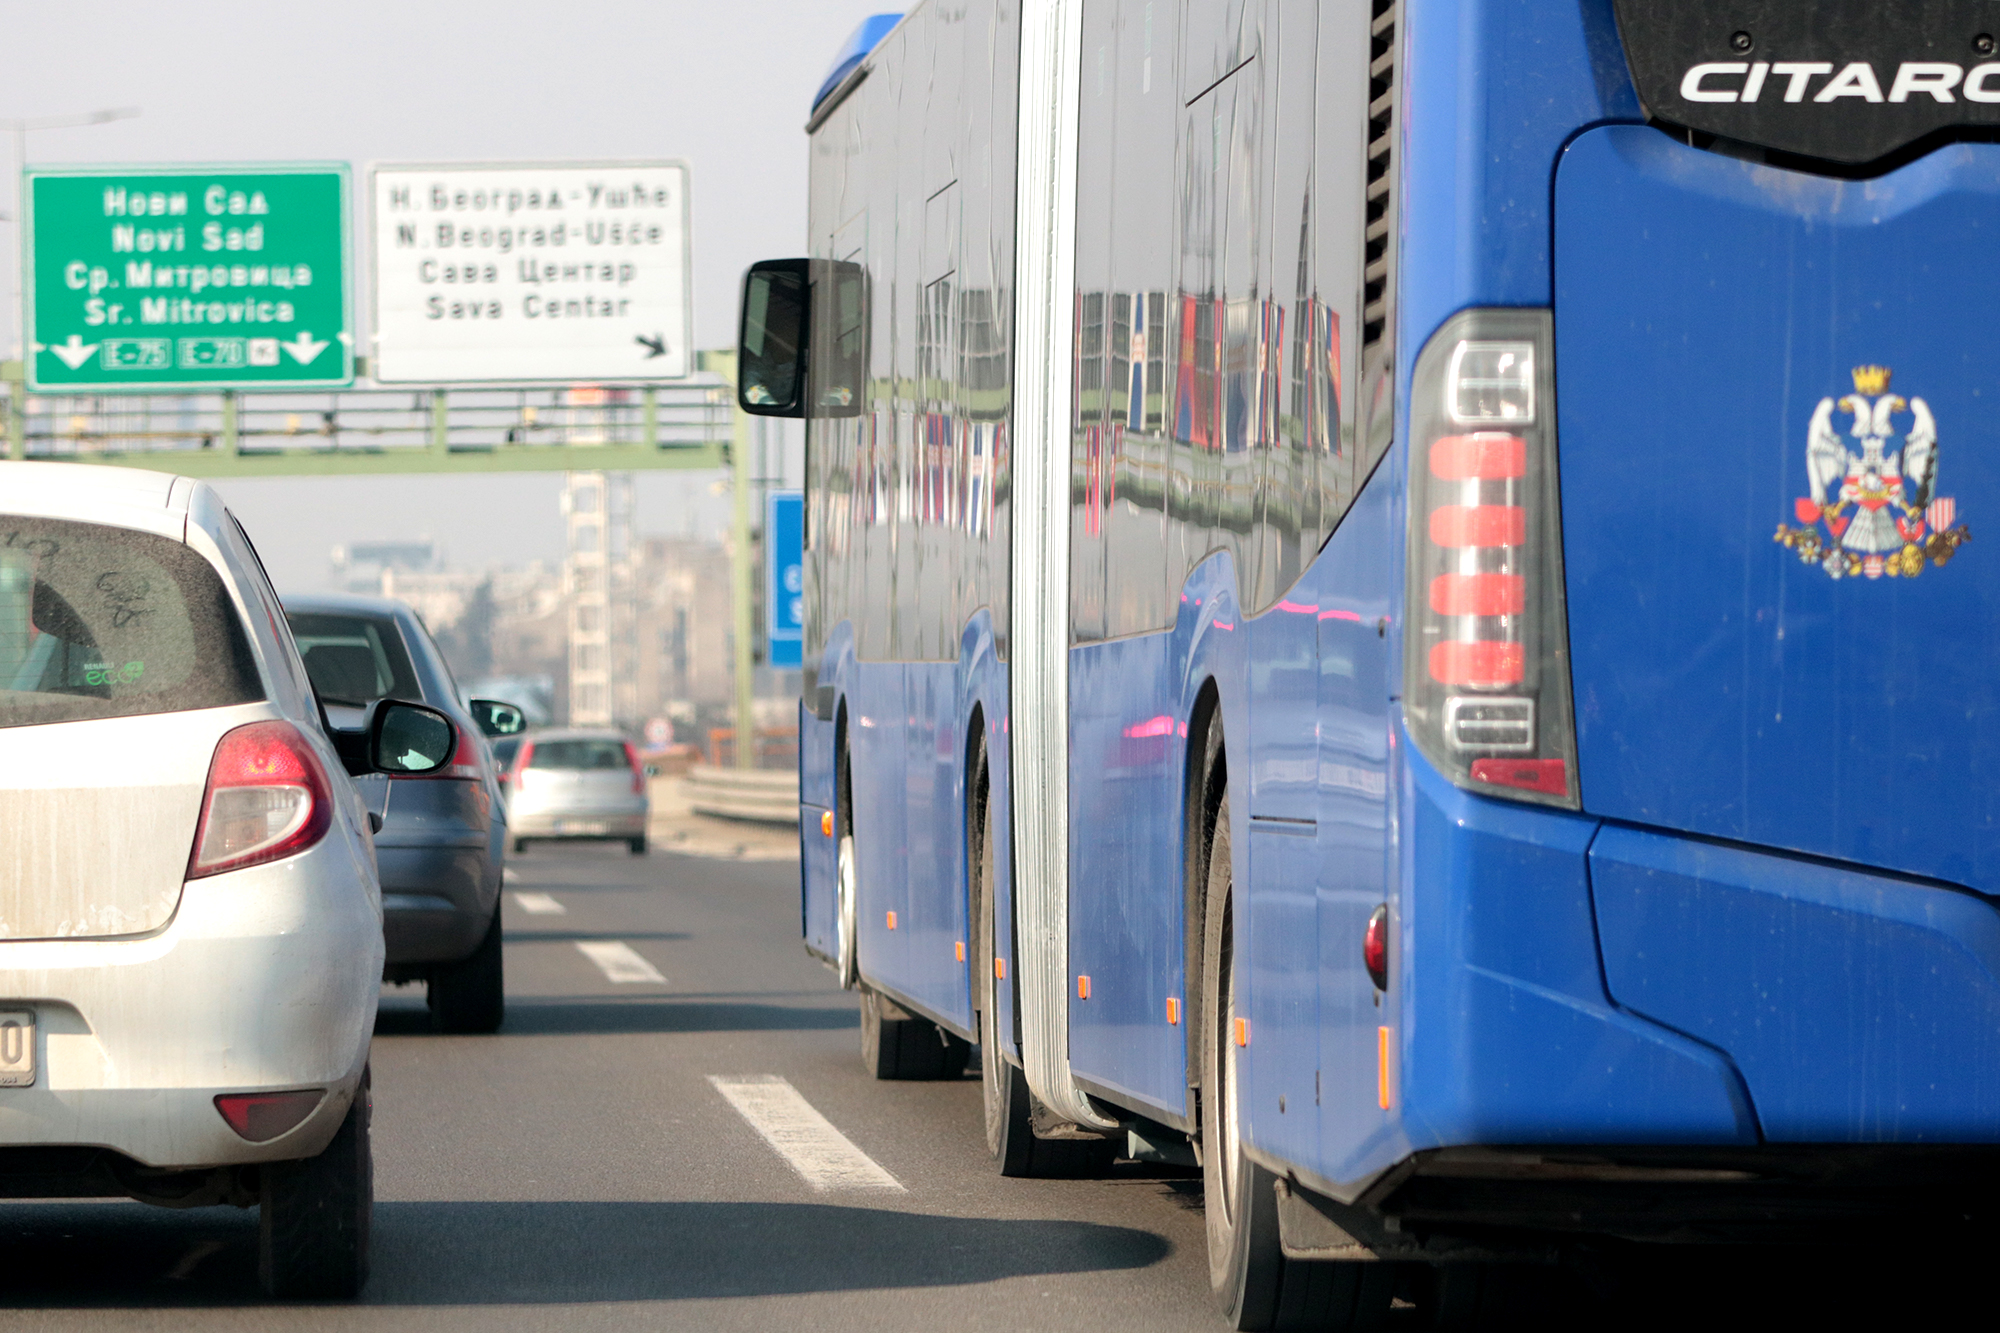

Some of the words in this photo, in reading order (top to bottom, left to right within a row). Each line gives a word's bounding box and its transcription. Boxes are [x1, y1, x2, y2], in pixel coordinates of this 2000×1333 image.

[103, 186, 188, 216] Нови
[204, 184, 269, 215] Сад
[111, 222, 185, 253] Novi
[201, 221, 264, 251] Sad
[125, 260, 312, 293] Митровица
[418, 258, 499, 284] Сава
[516, 257, 638, 287] Центар
[84, 297, 133, 326] Sr.
[140, 296, 295, 325] Mitrovica
[425, 294, 503, 320] Sava
[522, 293, 634, 319] Centar
